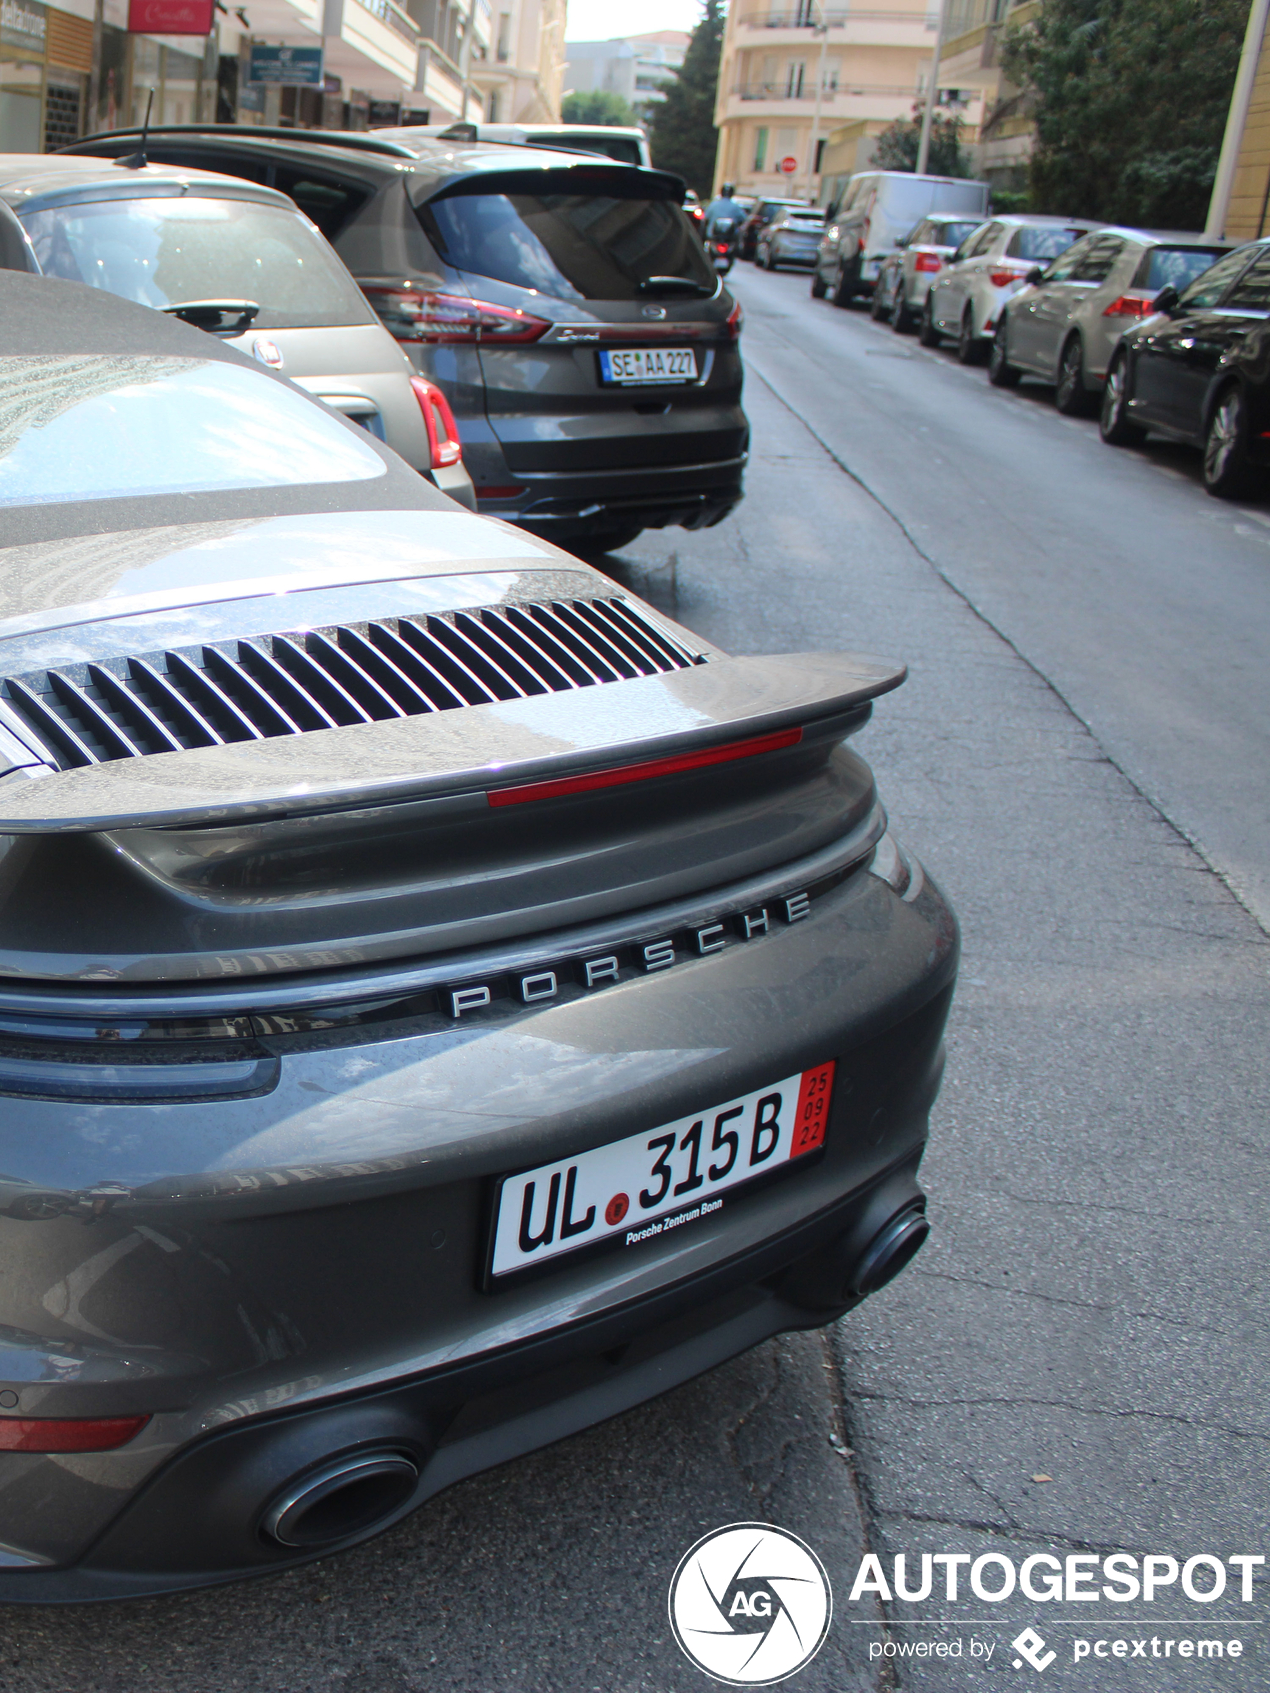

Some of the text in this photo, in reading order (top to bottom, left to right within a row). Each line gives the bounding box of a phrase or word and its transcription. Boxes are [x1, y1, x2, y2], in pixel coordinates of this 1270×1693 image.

[612, 352, 693, 377] SE AA 227
[452, 892, 811, 1018] PORSCHE
[807, 1072, 829, 1098] 25
[803, 1097, 825, 1122] 09
[800, 1122, 822, 1146] 22
[518, 1165, 597, 1252] UL
[626, 1198, 723, 1246] Porsche Zentrum Bonn
